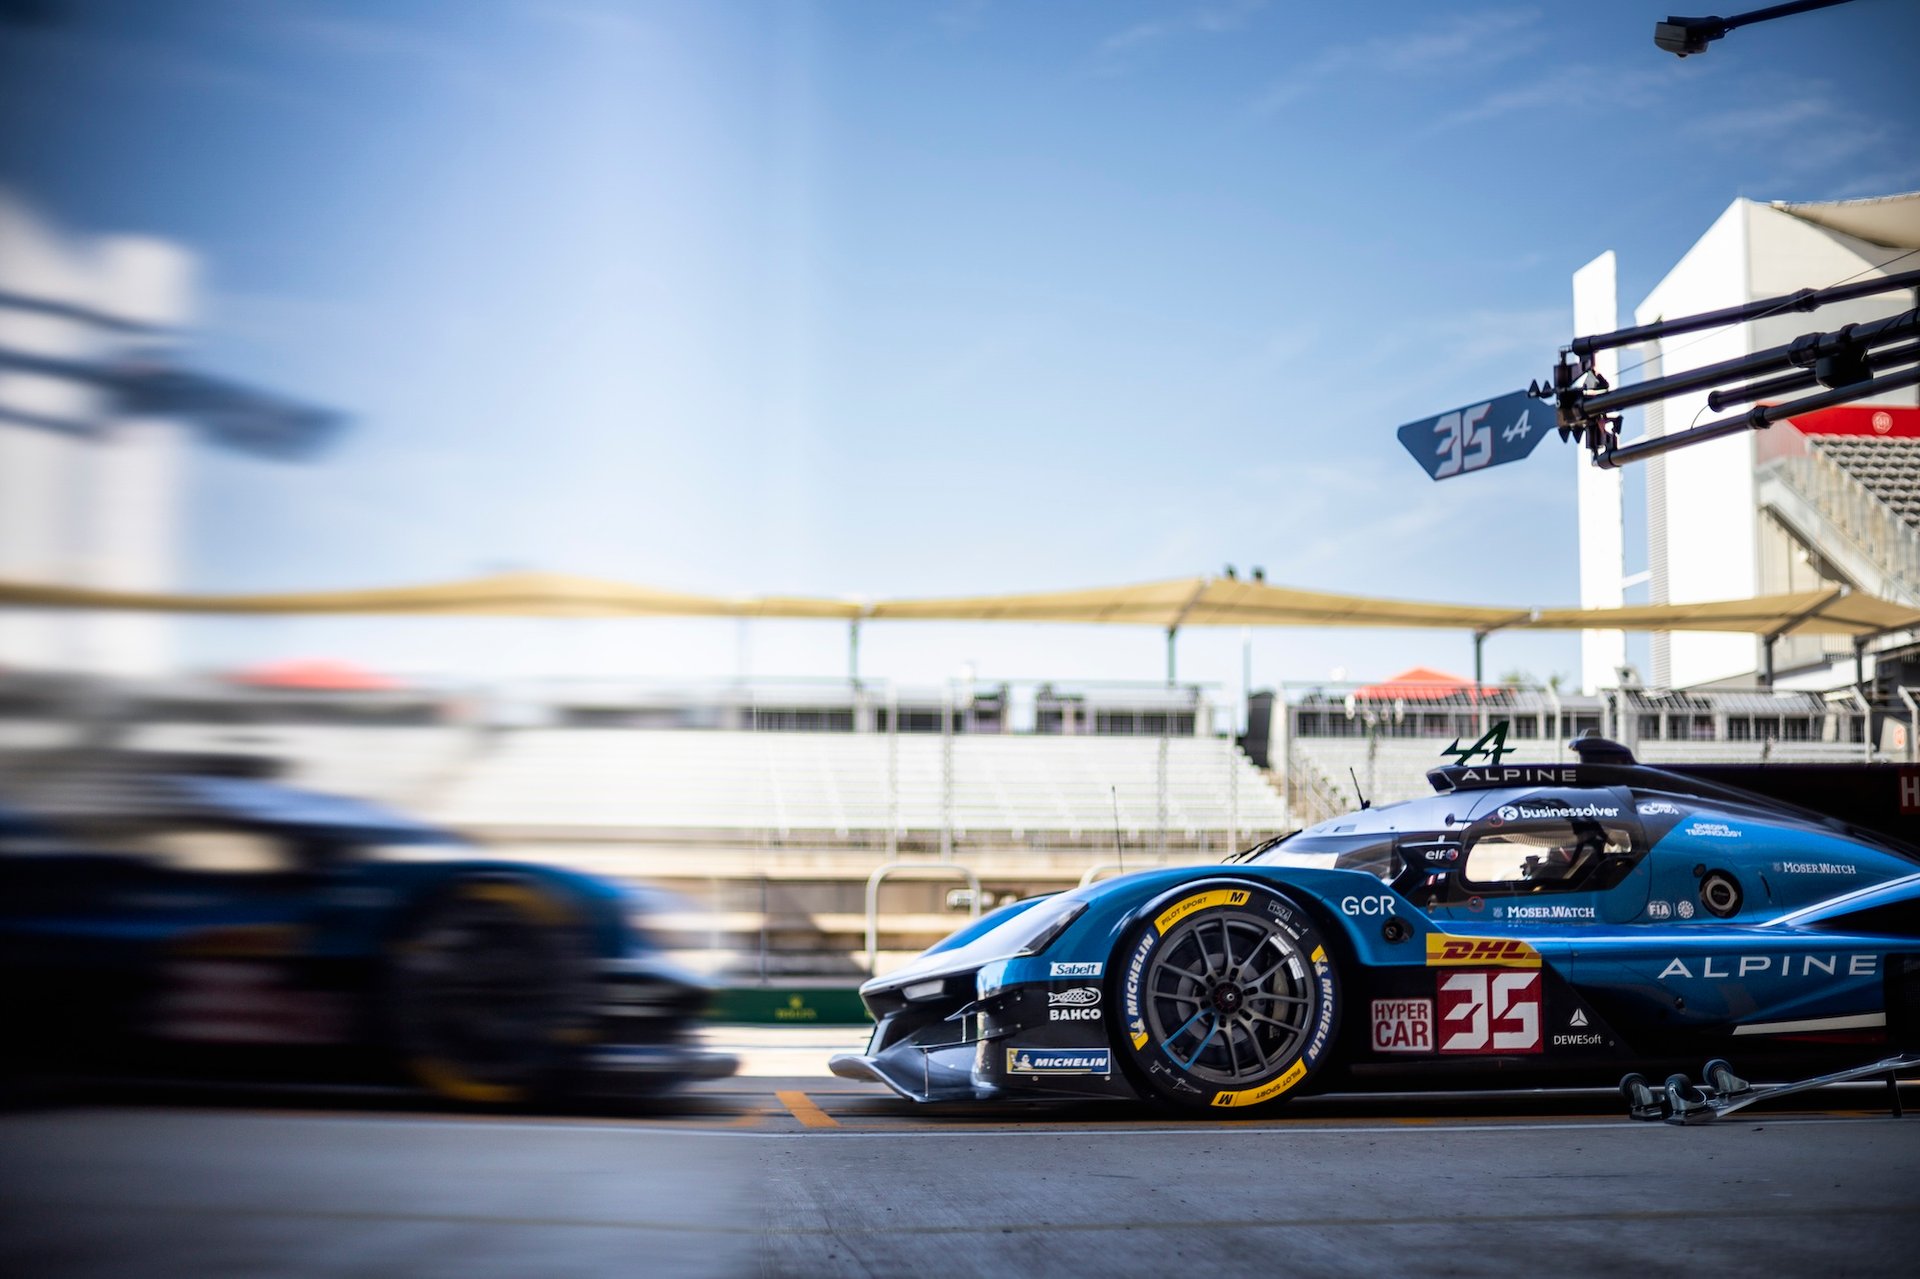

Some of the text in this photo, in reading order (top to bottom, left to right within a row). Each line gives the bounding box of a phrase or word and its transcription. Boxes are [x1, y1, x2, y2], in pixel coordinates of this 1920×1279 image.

[1433, 402, 1492, 479] 35
[1461, 768, 1577, 782] ALPINE
[1520, 803, 1619, 819] businessolver
[1425, 849, 1446, 860] elf
[1161, 908, 1181, 926] PILOT
[1182, 897, 1207, 912] SPORT
[1341, 895, 1396, 916] GCR
[1649, 904, 1670, 916] FIA
[1441, 941, 1527, 960] DHL
[1055, 964, 1097, 975] Sabelt
[1127, 933, 1155, 1016] MICHELIN
[1657, 954, 1878, 979] ALPINE
[1049, 1008, 1101, 1020] BAHCO
[1308, 978, 1333, 1060] MICHELIN
[1375, 1003, 1428, 1020] HYPER
[1440, 972, 1540, 1050] 35
[1375, 1020, 1429, 1047] CAR
[1553, 1034, 1601, 1045] DEWESoft
[1034, 1058, 1107, 1067] MICHELIN
[1256, 1084, 1281, 1099] SPORT
